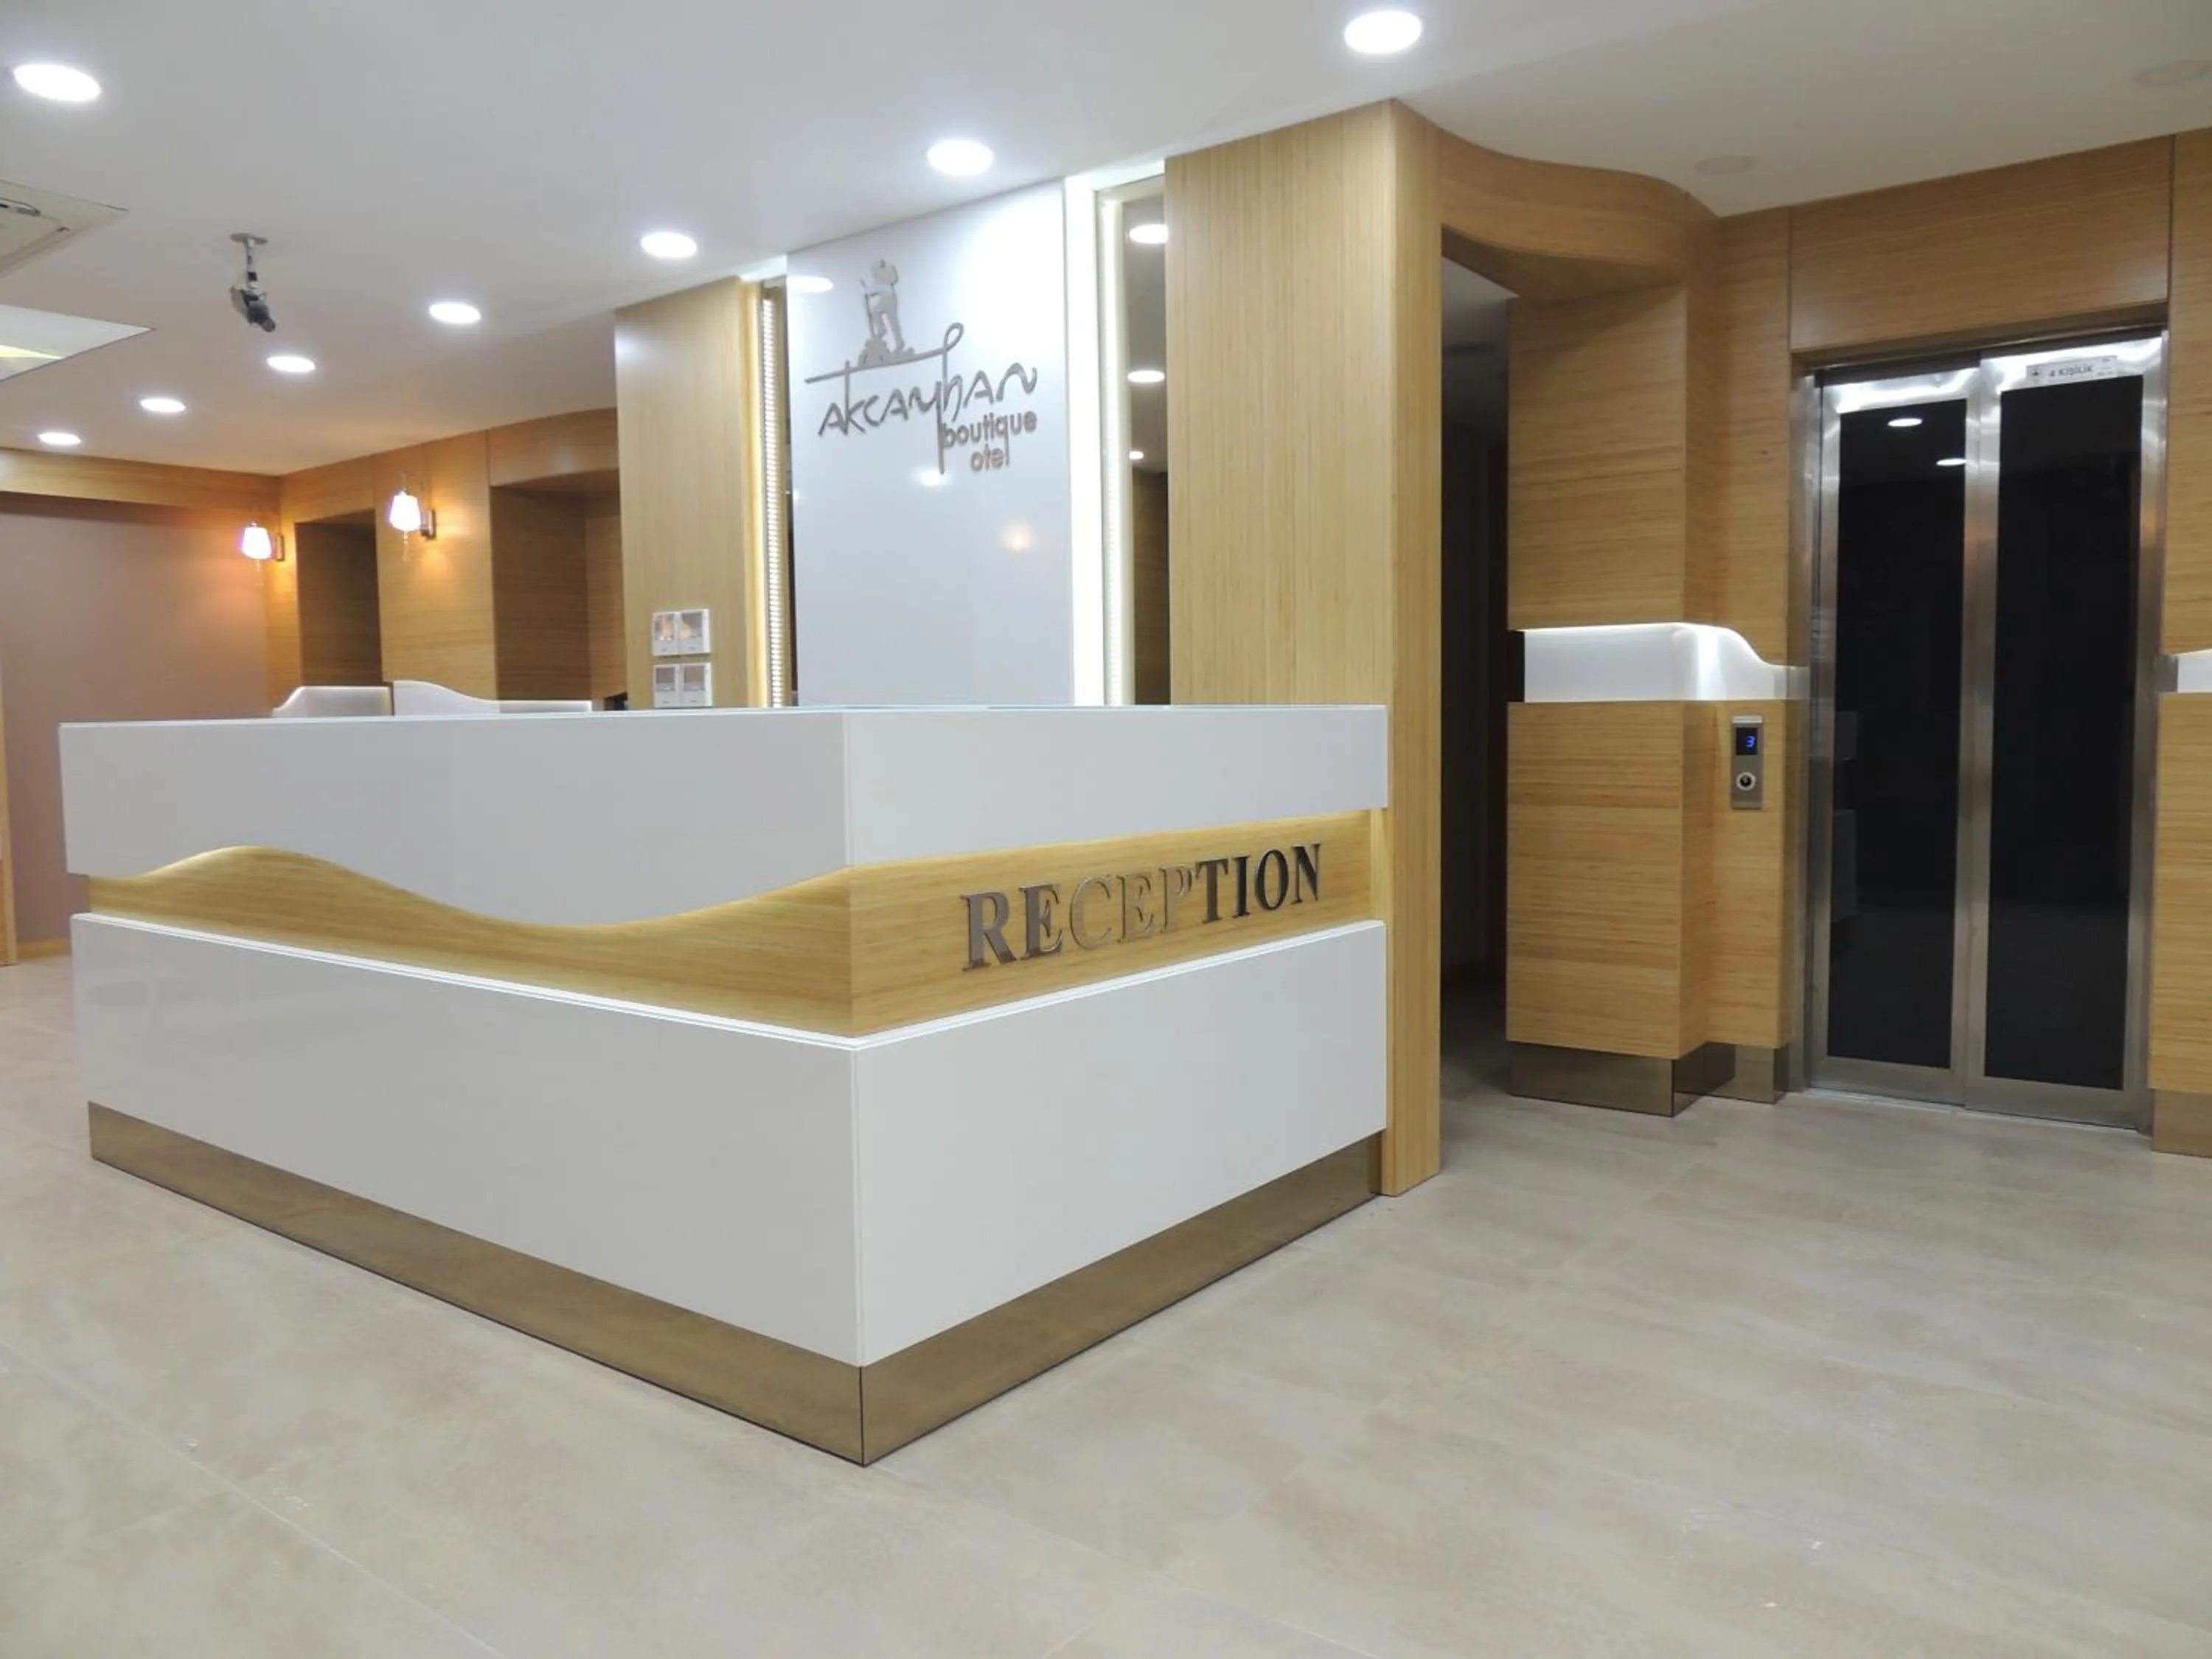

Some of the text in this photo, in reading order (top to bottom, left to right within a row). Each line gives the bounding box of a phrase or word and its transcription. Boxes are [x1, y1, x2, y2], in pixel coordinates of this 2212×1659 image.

[942, 410, 1037, 449] boutique
[970, 443, 1010, 473] otel
[1745, 735, 1756, 748] 3
[961, 843, 1321, 972] RECEPTION
